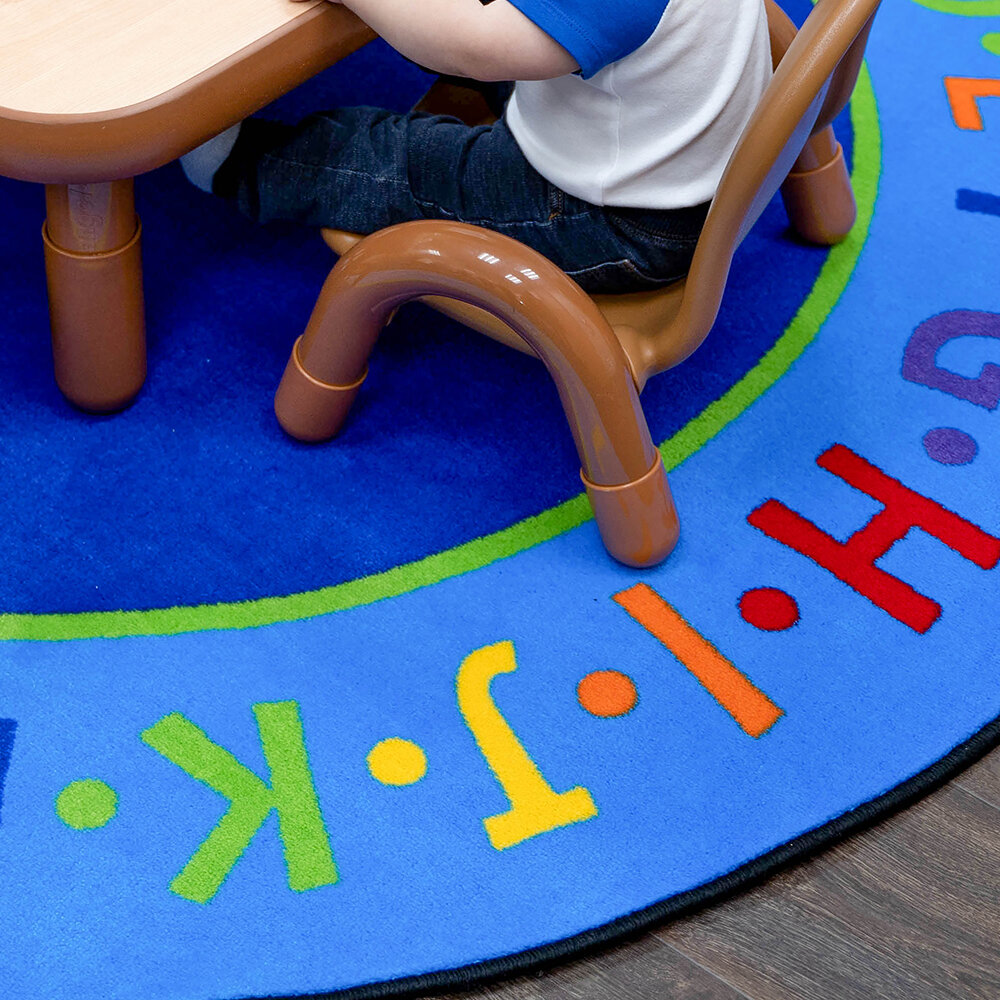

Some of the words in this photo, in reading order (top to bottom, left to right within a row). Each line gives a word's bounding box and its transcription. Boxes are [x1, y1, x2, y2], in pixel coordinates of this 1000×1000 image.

[747, 443, 1000, 635] H
[455, 640, 598, 851] J
[611, 582, 785, 739] I
[139, 699, 339, 904] K
